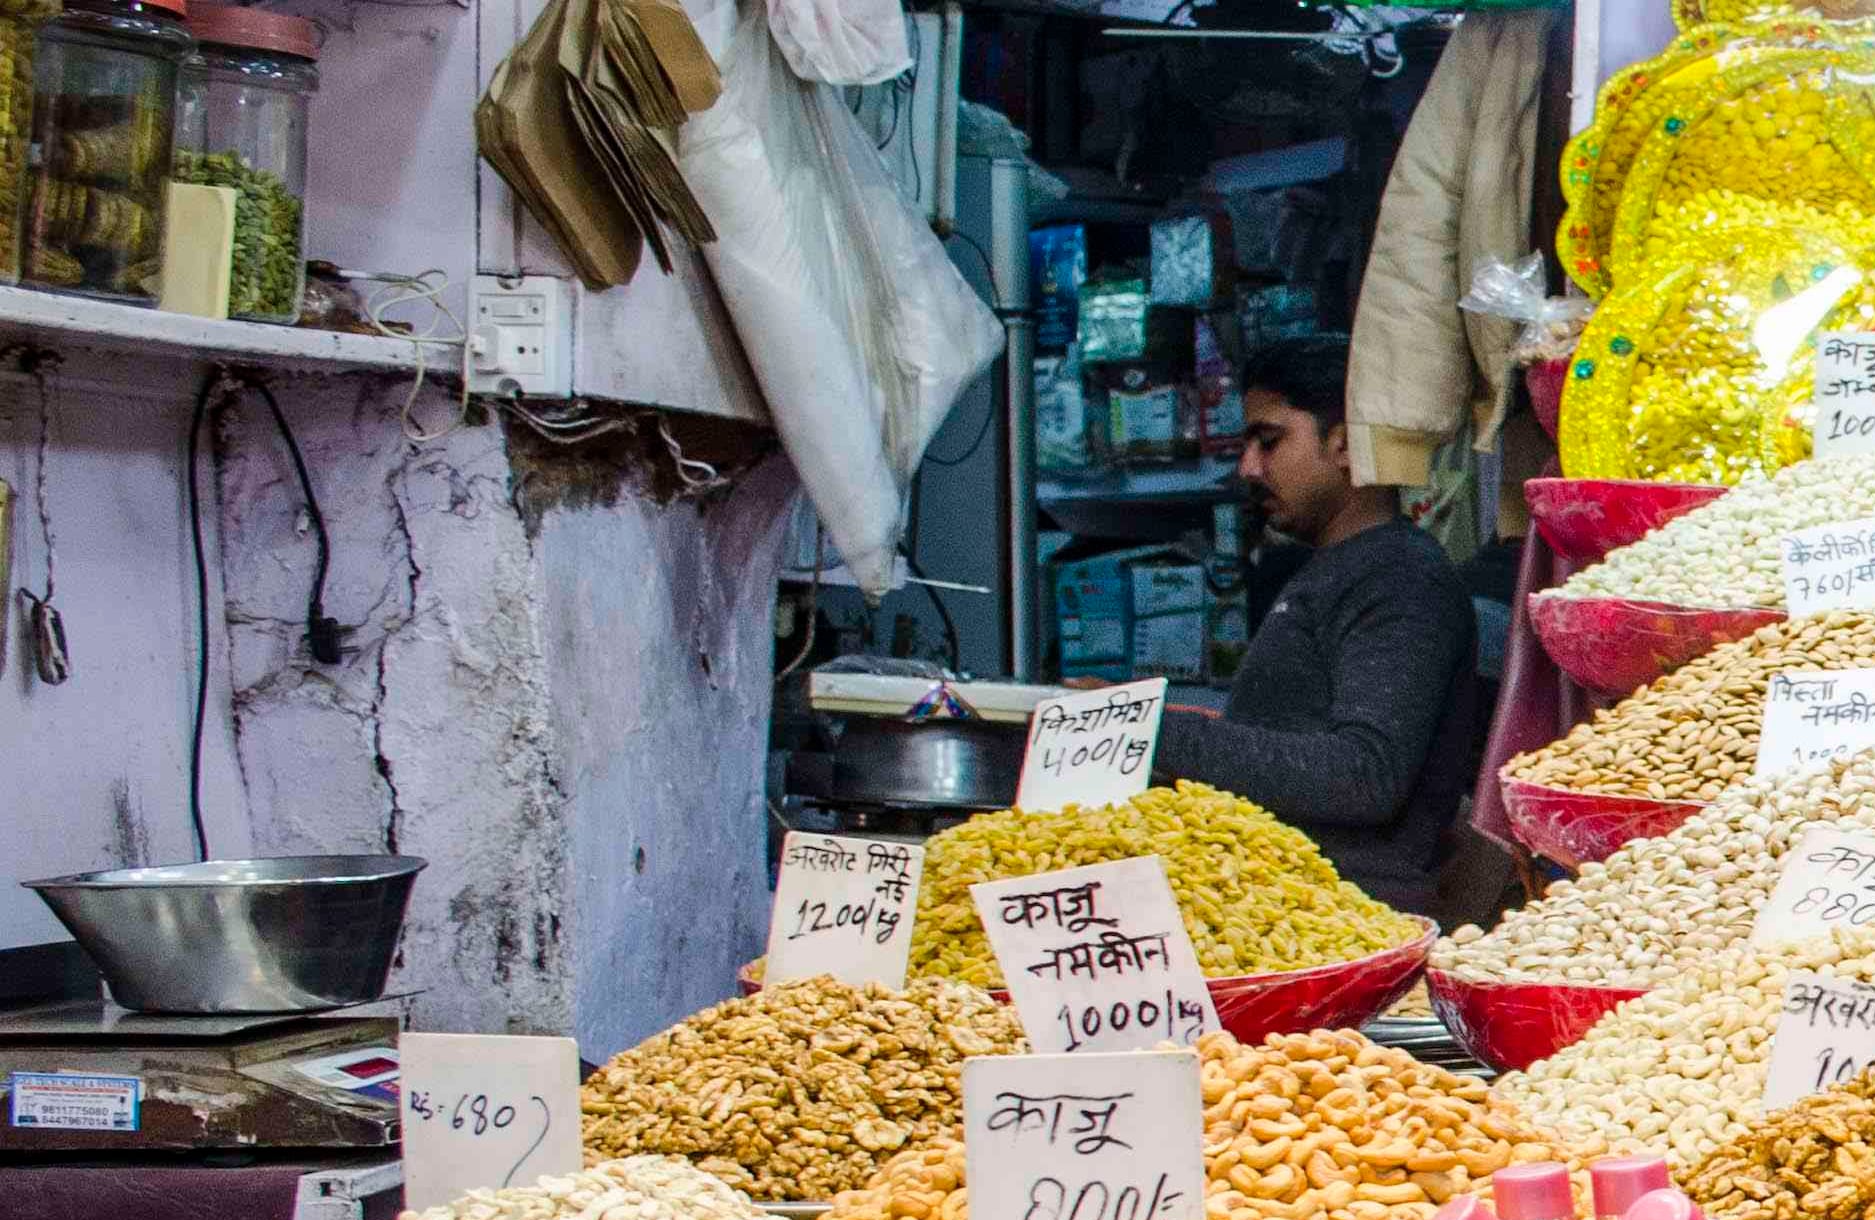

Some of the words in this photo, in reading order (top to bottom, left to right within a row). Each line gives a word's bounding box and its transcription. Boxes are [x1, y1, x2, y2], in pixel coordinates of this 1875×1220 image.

[1000, 881, 1120, 932] काजू
[1027, 931, 1171, 980] नमकीन
[452, 1094, 516, 1135] 680
[987, 1092, 1134, 1154] काजू
